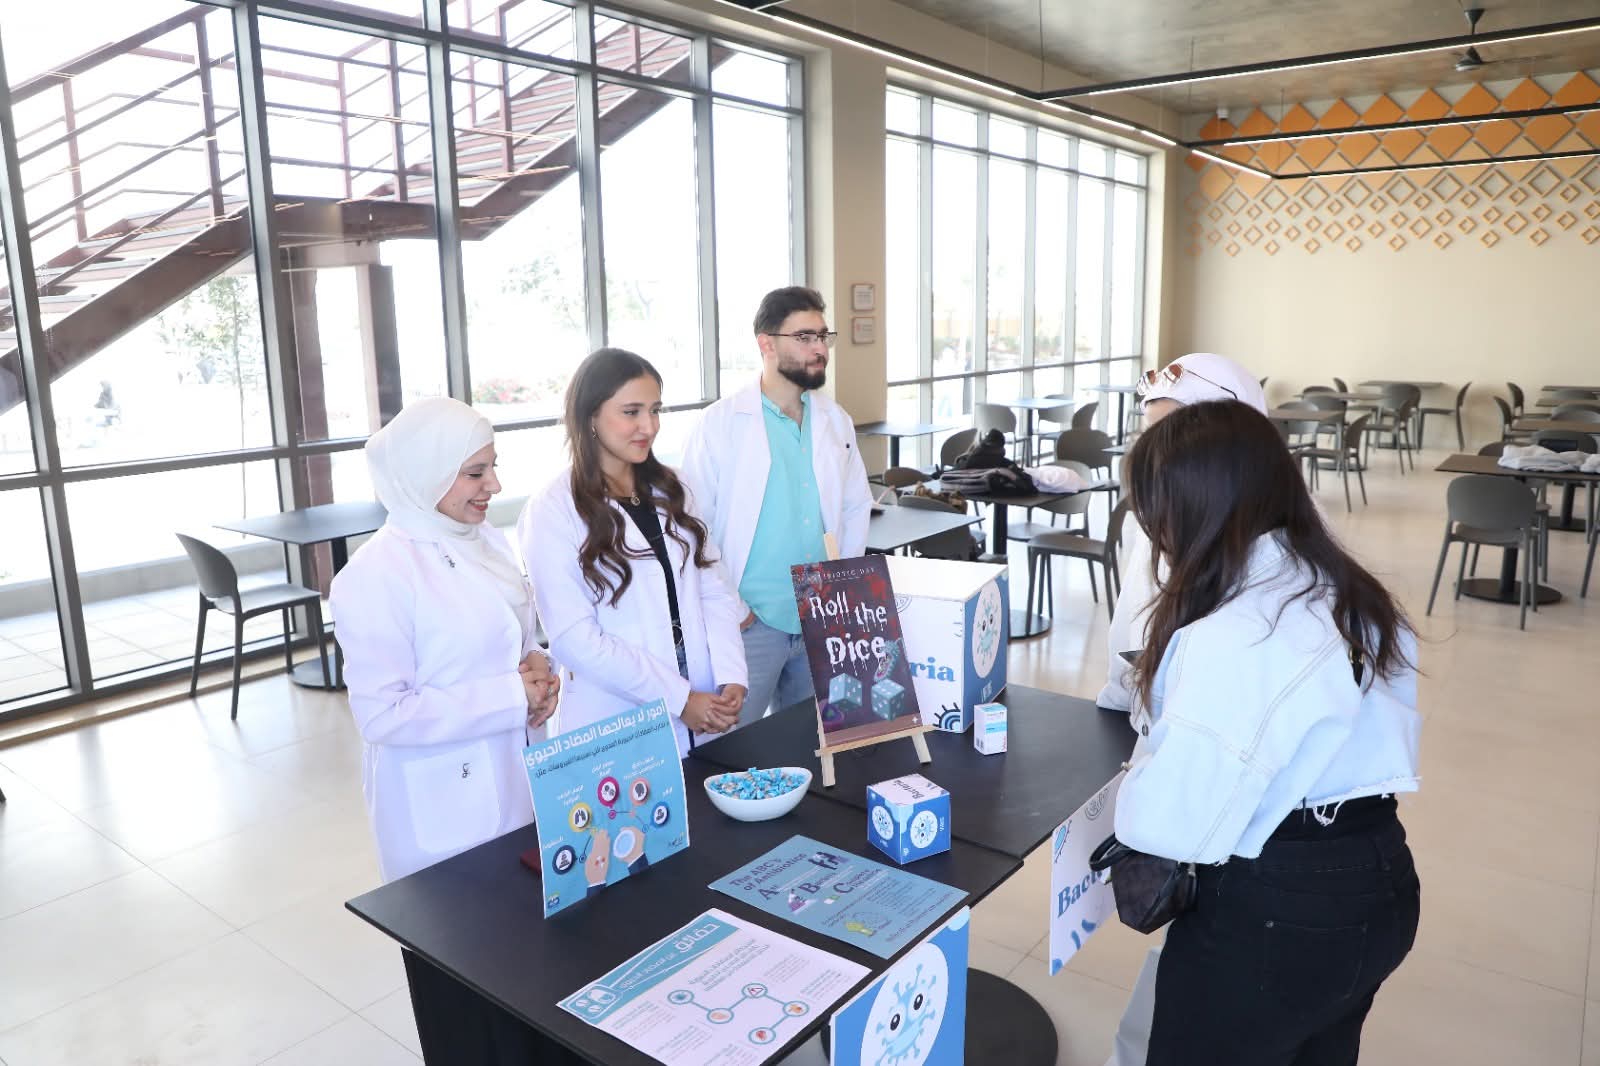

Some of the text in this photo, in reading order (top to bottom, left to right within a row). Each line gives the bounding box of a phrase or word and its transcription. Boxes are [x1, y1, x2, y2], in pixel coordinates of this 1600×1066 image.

[809, 591, 887, 629] Roll the
[826, 632, 886, 670] Dice
[908, 656, 956, 682] ria
[597, 715, 636, 737] يعالجها
[637, 709, 645, 722] لا
[563, 726, 597, 750] المضاد
[526, 739, 562, 770] الحيوي
[743, 879, 757, 891] of
[1057, 868, 1103, 919] Bact
[673, 922, 721, 953] حقائق
